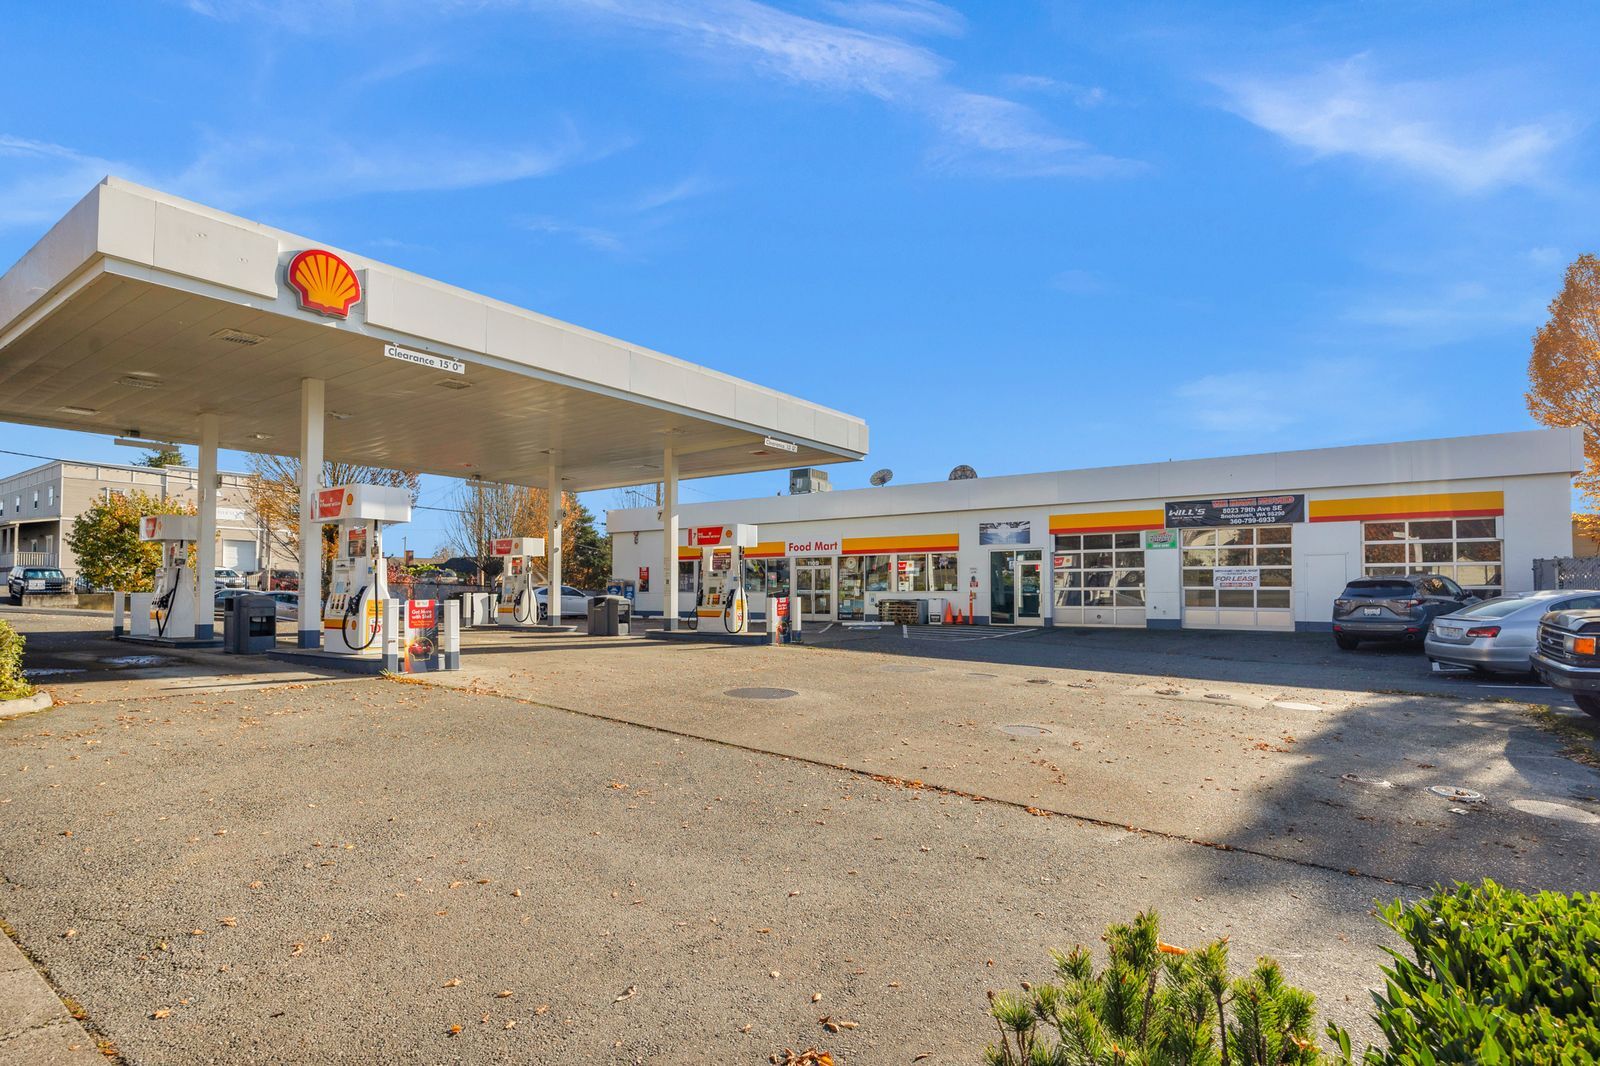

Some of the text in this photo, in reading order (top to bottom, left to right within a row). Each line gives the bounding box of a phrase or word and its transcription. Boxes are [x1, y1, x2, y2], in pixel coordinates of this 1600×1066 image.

[388, 348, 435, 365] Clearance
[1168, 508, 1206, 516] WILL'S
[788, 541, 838, 551] Food Mart
